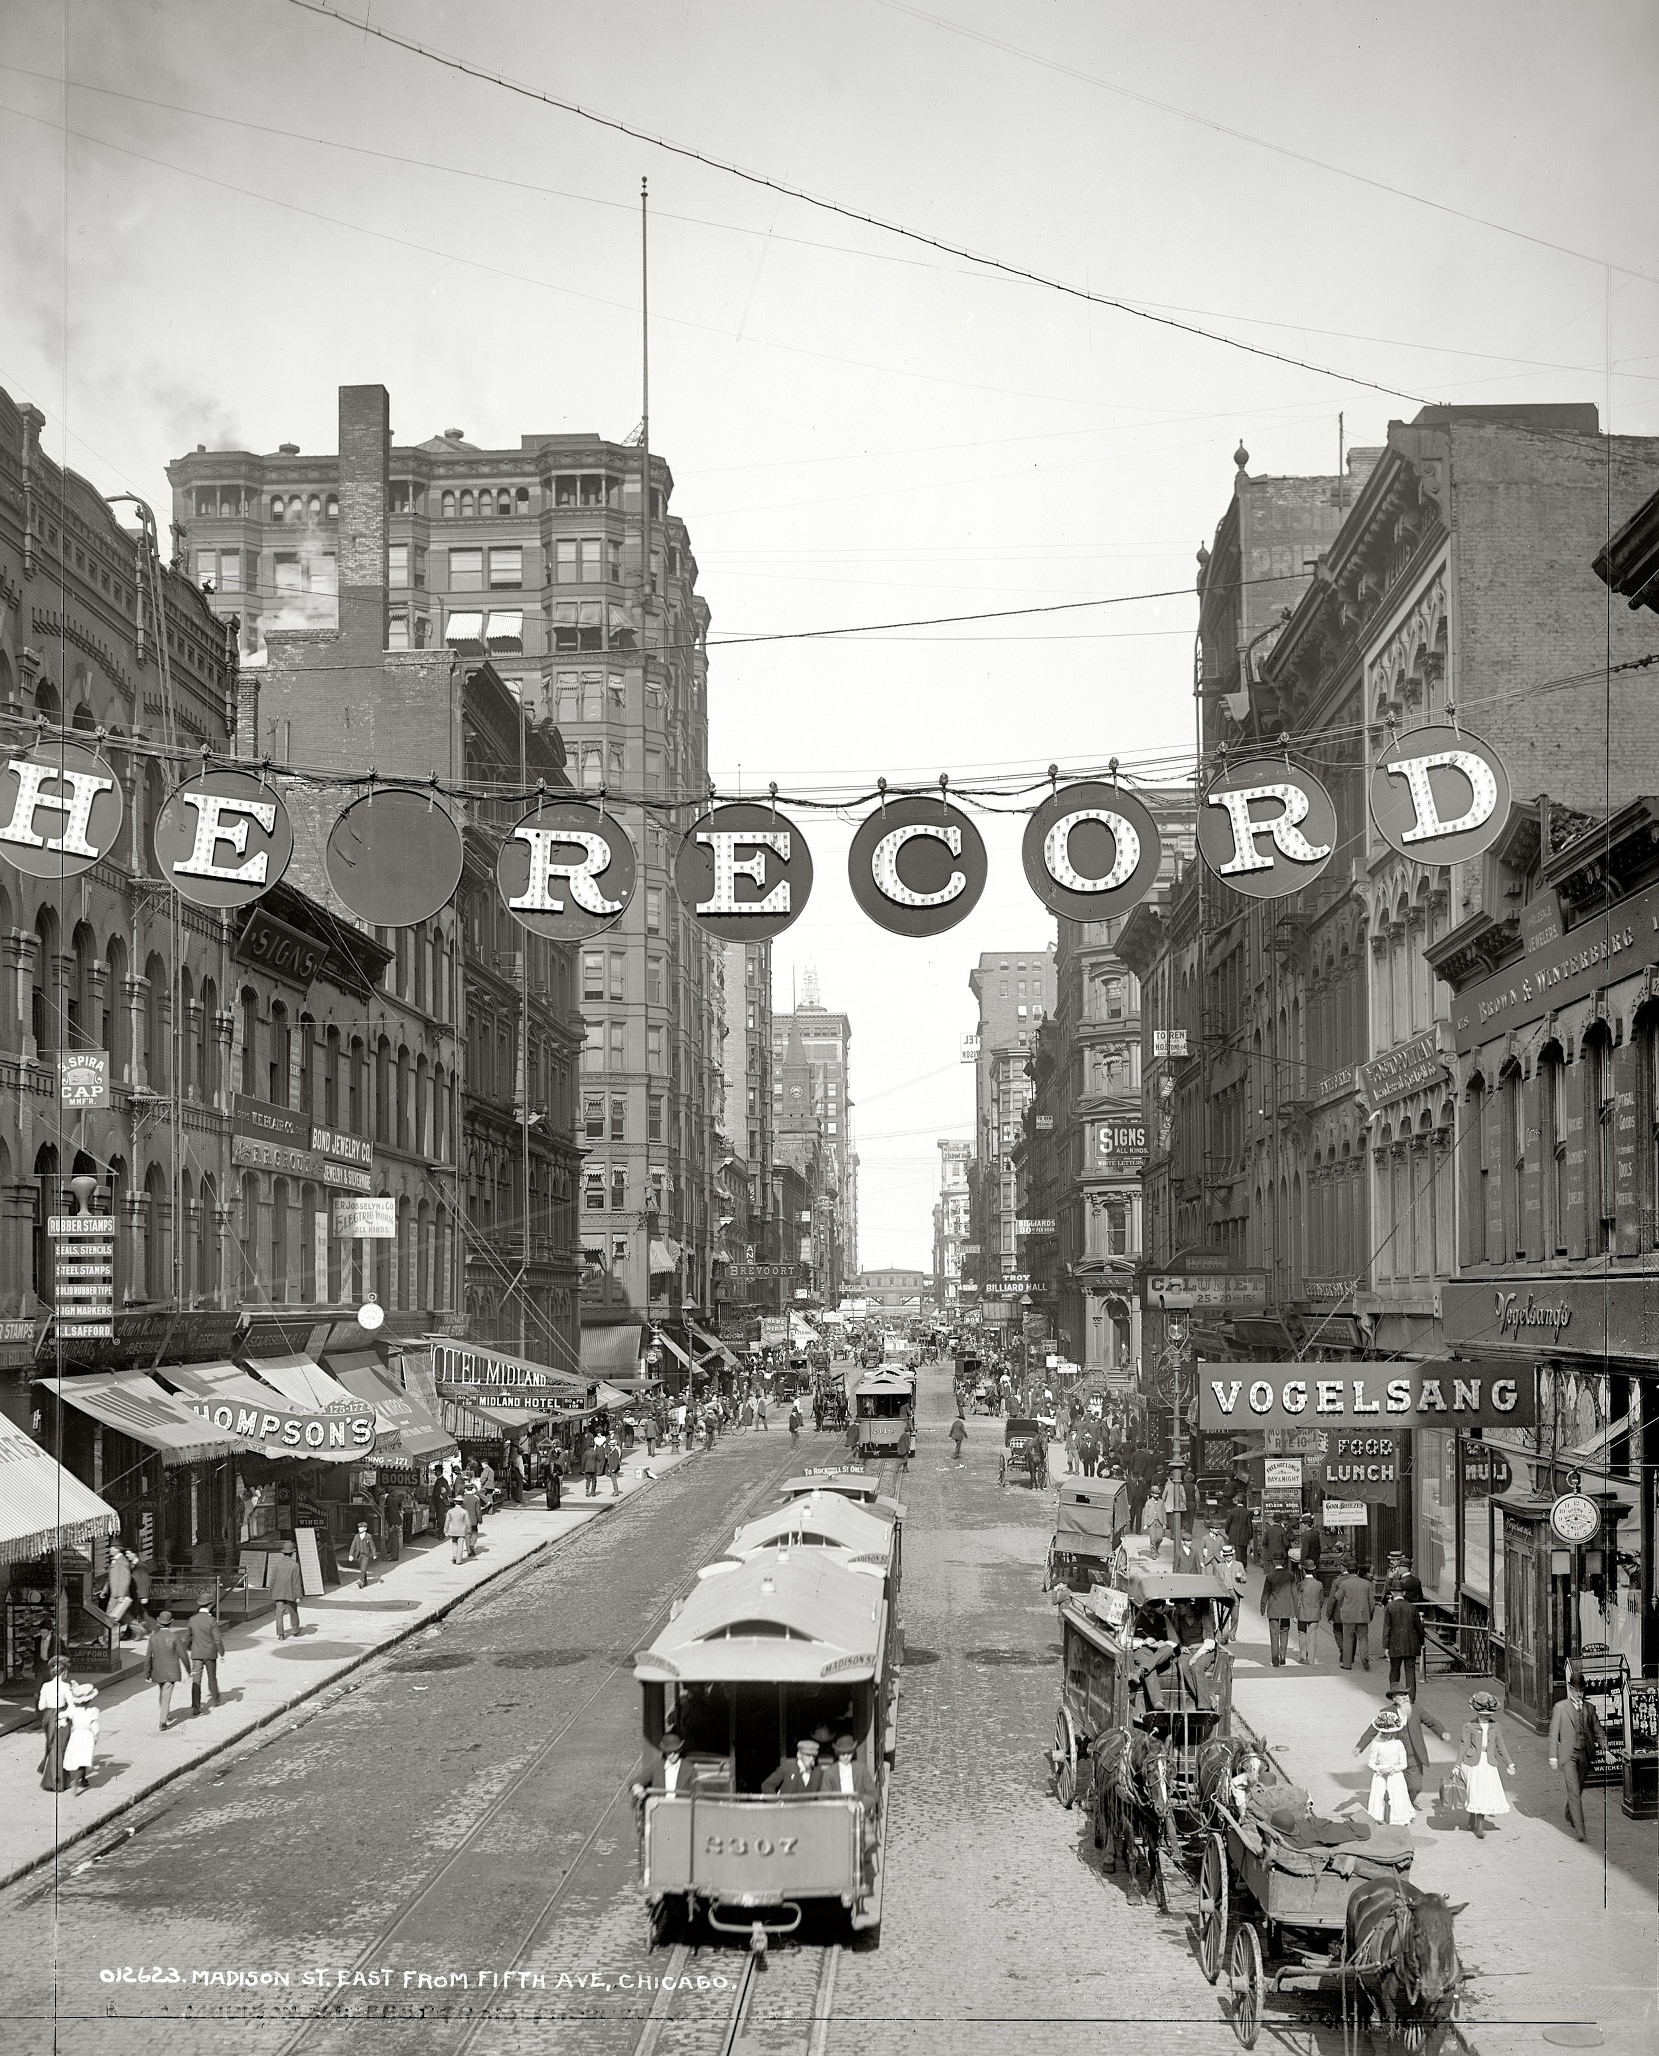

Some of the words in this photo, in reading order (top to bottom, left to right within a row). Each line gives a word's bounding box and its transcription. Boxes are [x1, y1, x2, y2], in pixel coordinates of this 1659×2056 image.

[509, 750, 1497, 914] RECORD
[253, 928, 317, 977] SIGNS
[1478, 988, 1518, 1024] BROWN
[1522, 978, 1533, 1002] &
[1535, 926, 1634, 994] WINTERBERG
[61, 1086, 103, 1098] CAP
[312, 1127, 331, 1152] BOND
[332, 1134, 361, 1160] JEWELRY
[1100, 1128, 1145, 1154] SIGNS
[323, 1165, 343, 1182] JEWELRY
[343, 1170, 348, 1183] &
[348, 1171, 371, 1190] SILVERWARE
[50, 1220, 81, 1232] RUBBER
[83, 1219, 113, 1232] STAMPS
[81, 1245, 112, 1255] STENCILS
[56, 1266, 79, 1275] STEEL
[80, 1266, 111, 1275] STAMPS
[730, 1266, 795, 1276] BREVOORT
[55, 1286, 73, 1295] SOLID
[74, 1286, 97, 1295] RUBBER
[98, 1286, 112, 1295] TYPE
[986, 1283, 1024, 1292] BILLIARD
[1026, 1283, 1048, 1291] HALL
[56, 1307, 75, 1316] SIGN
[77, 1306, 112, 1315] MARKERS
[431, 1344, 480, 1384] OTEL
[486, 1359, 546, 1387] MIDLAND
[479, 1397, 520, 1407] MIDLAND
[525, 1398, 561, 1408] HOTEL
[1211, 1379, 1518, 1413] VOGELSANG
[1338, 1439, 1393, 1456] FOOD
[1266, 1464, 1277, 1473] FREE
[1326, 1465, 1394, 1481] LUNCH
[382, 1474, 418, 1484] BOOKS
[822, 1655, 864, 1674] MADISON
